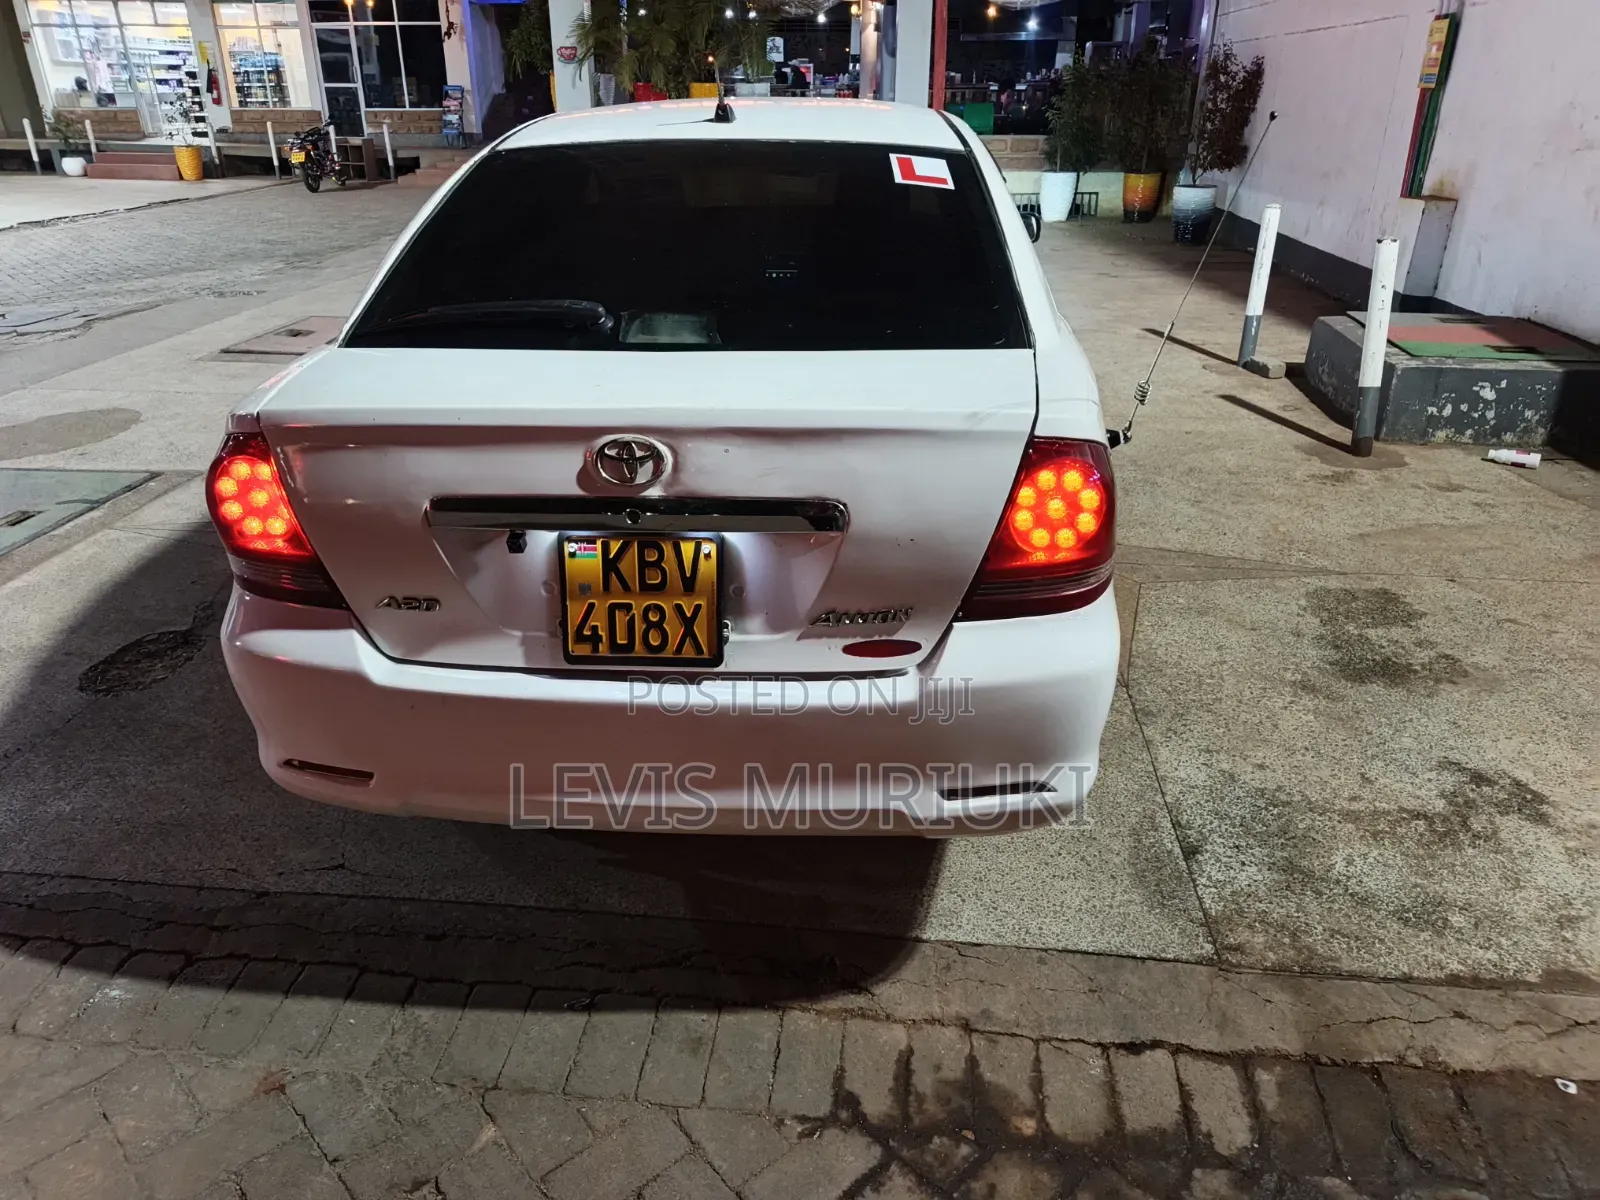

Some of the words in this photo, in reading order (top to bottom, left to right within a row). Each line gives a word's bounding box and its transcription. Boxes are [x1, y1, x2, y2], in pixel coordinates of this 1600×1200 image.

[895, 156, 949, 186] L
[600, 538, 703, 593] KBV
[573, 601, 705, 656] 408X
